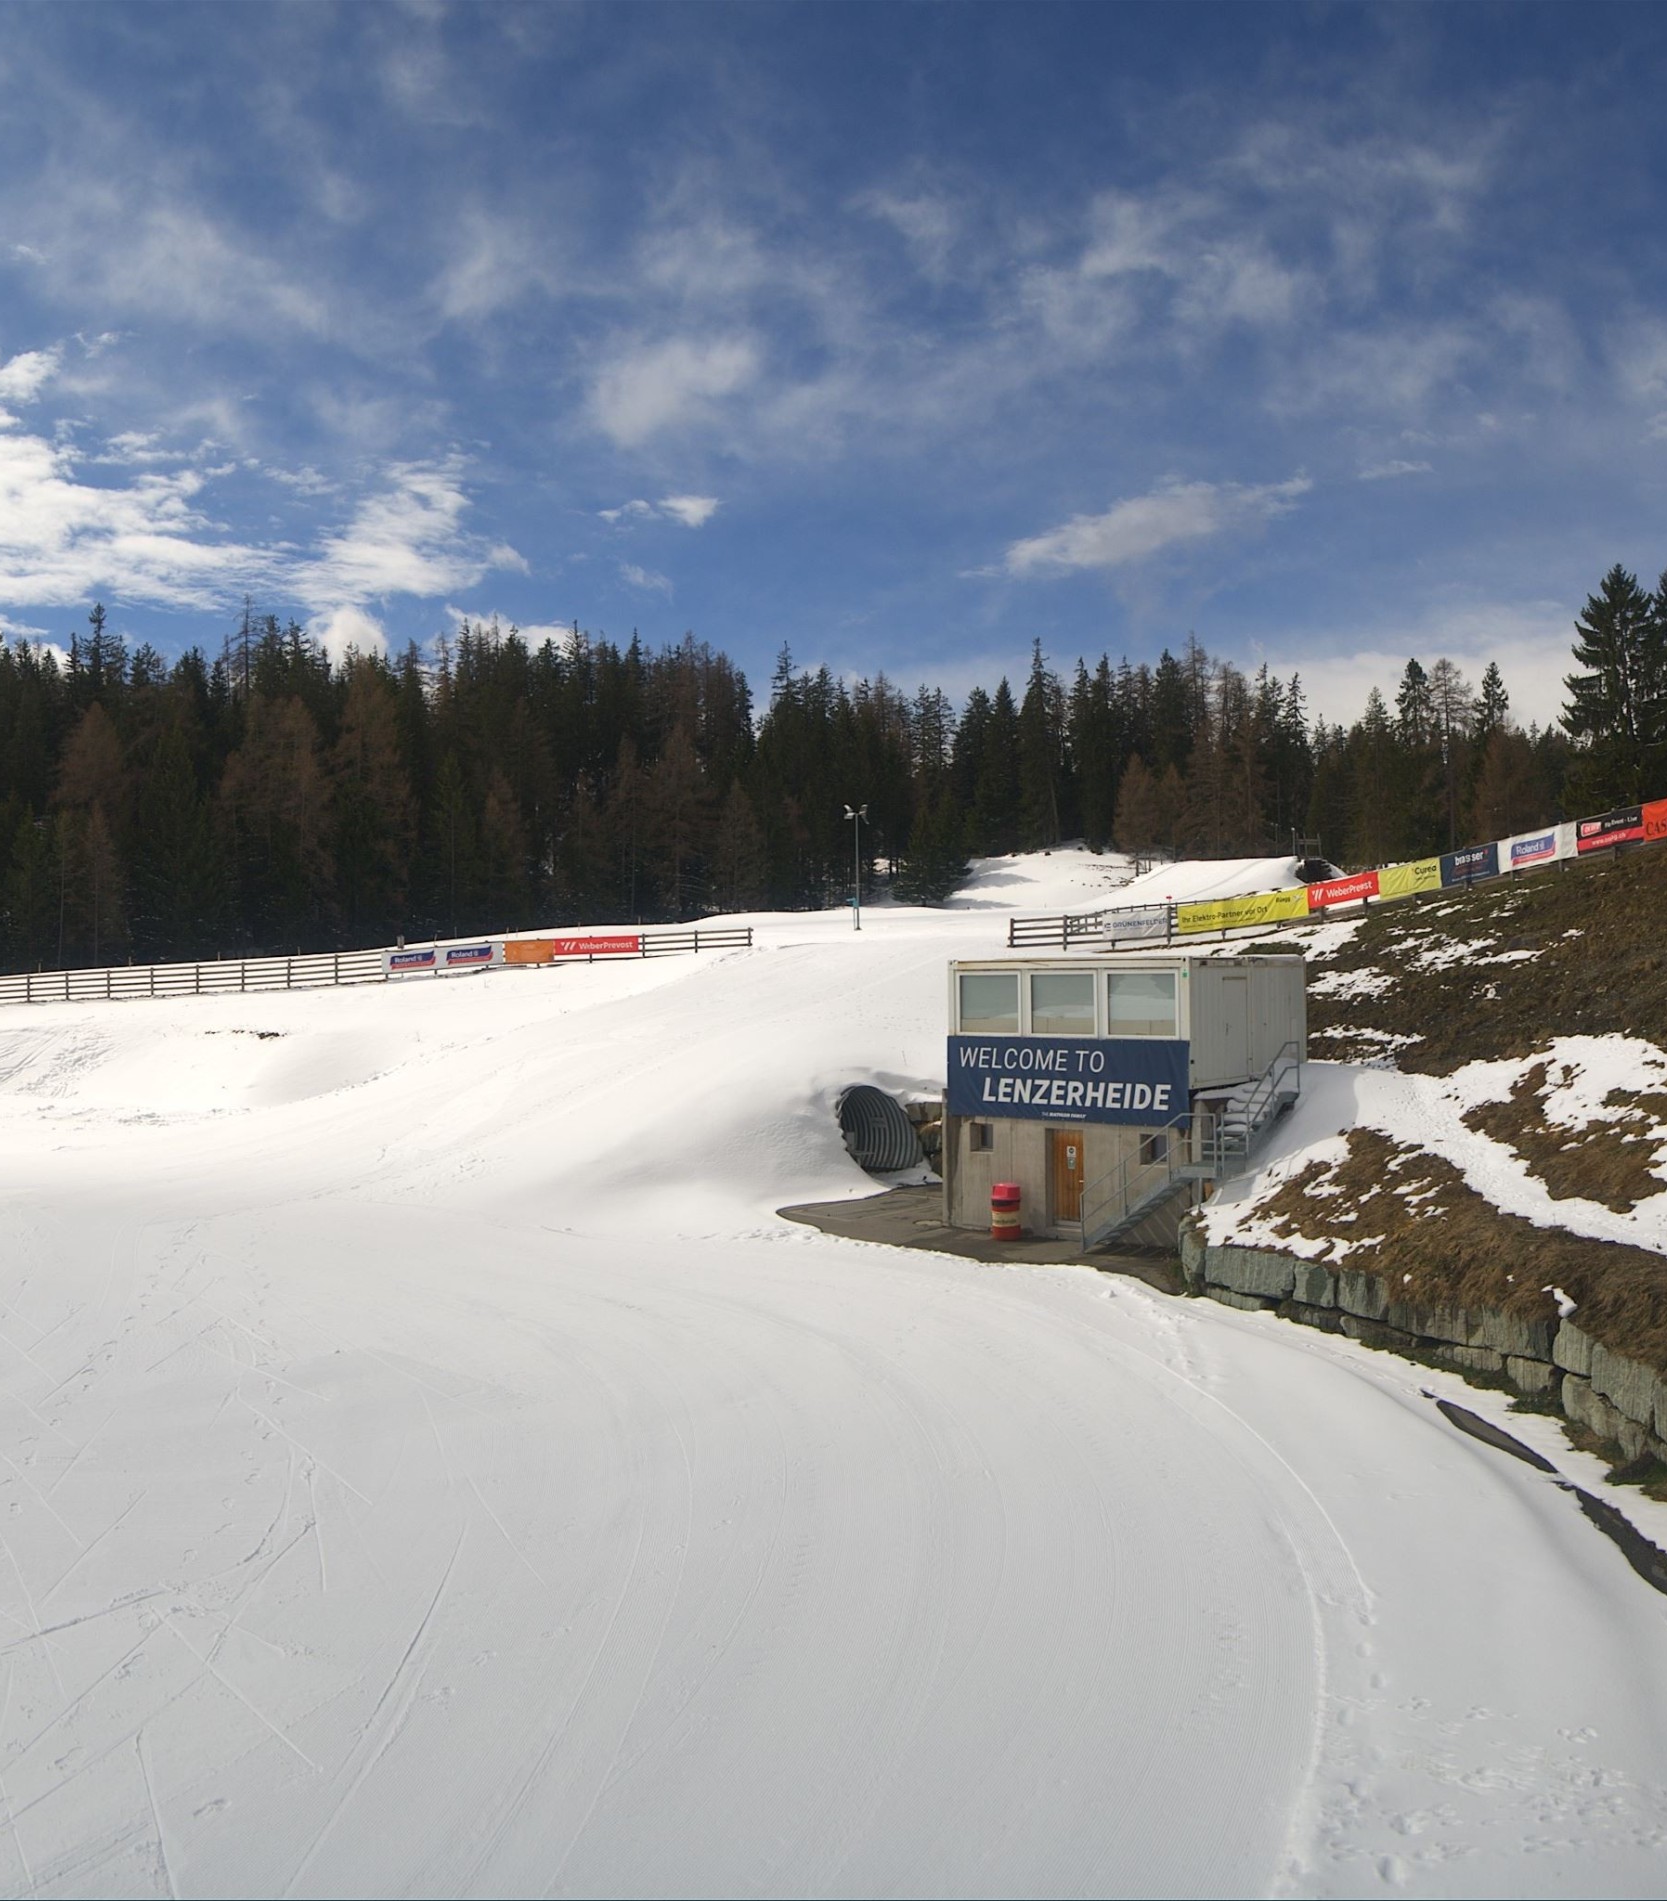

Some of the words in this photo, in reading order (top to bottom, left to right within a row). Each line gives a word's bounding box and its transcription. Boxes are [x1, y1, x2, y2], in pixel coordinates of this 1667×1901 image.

[1515, 843, 1539, 855] Roland
[1414, 865, 1436, 875] Curea
[1193, 911, 1243, 922] Elektro-Partner
[395, 955, 417, 963] Roland
[451, 950, 472, 958] Roland
[959, 1046, 1069, 1072] WELCOME
[1075, 1049, 1105, 1073] TO
[982, 1077, 1172, 1111] LENZERHEIDE
